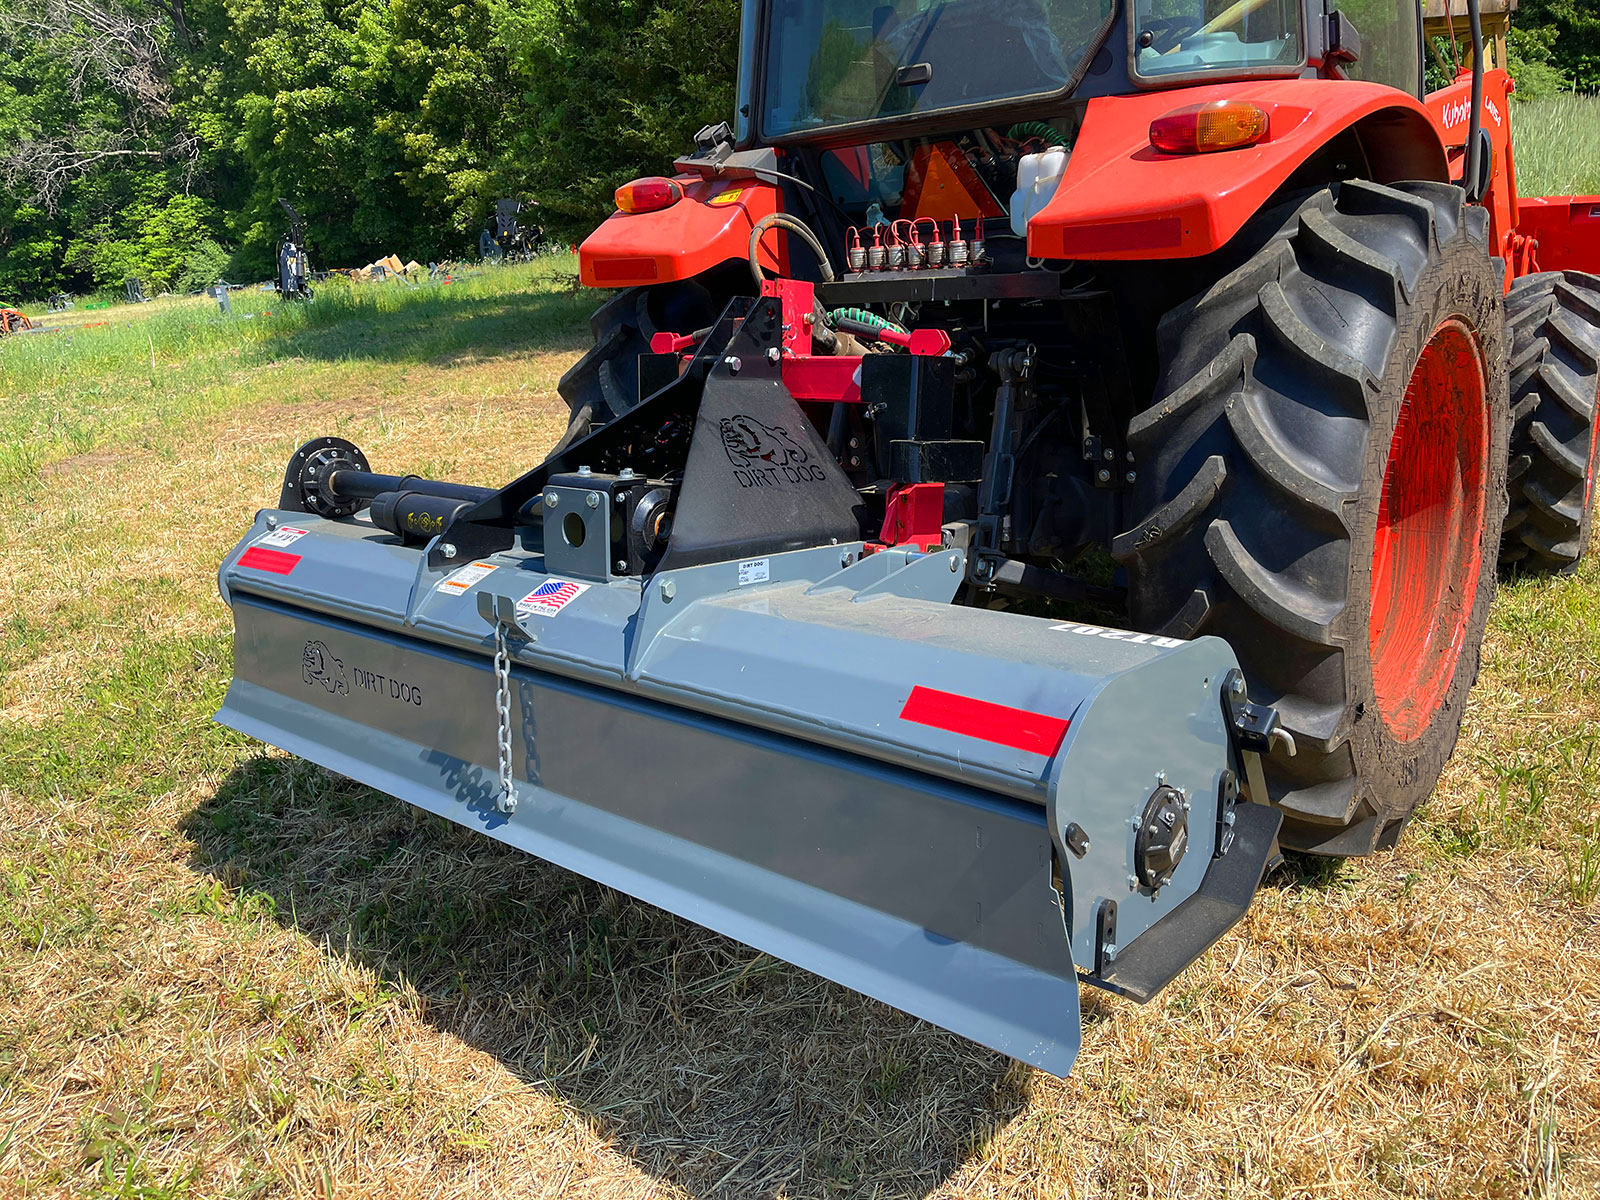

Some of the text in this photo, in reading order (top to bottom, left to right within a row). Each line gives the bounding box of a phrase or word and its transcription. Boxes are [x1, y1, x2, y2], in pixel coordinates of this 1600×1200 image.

[733, 465, 826, 488] DIRT DOG
[1047, 623, 1187, 648] RT207
[353, 668, 422, 706] DIRT DOG
